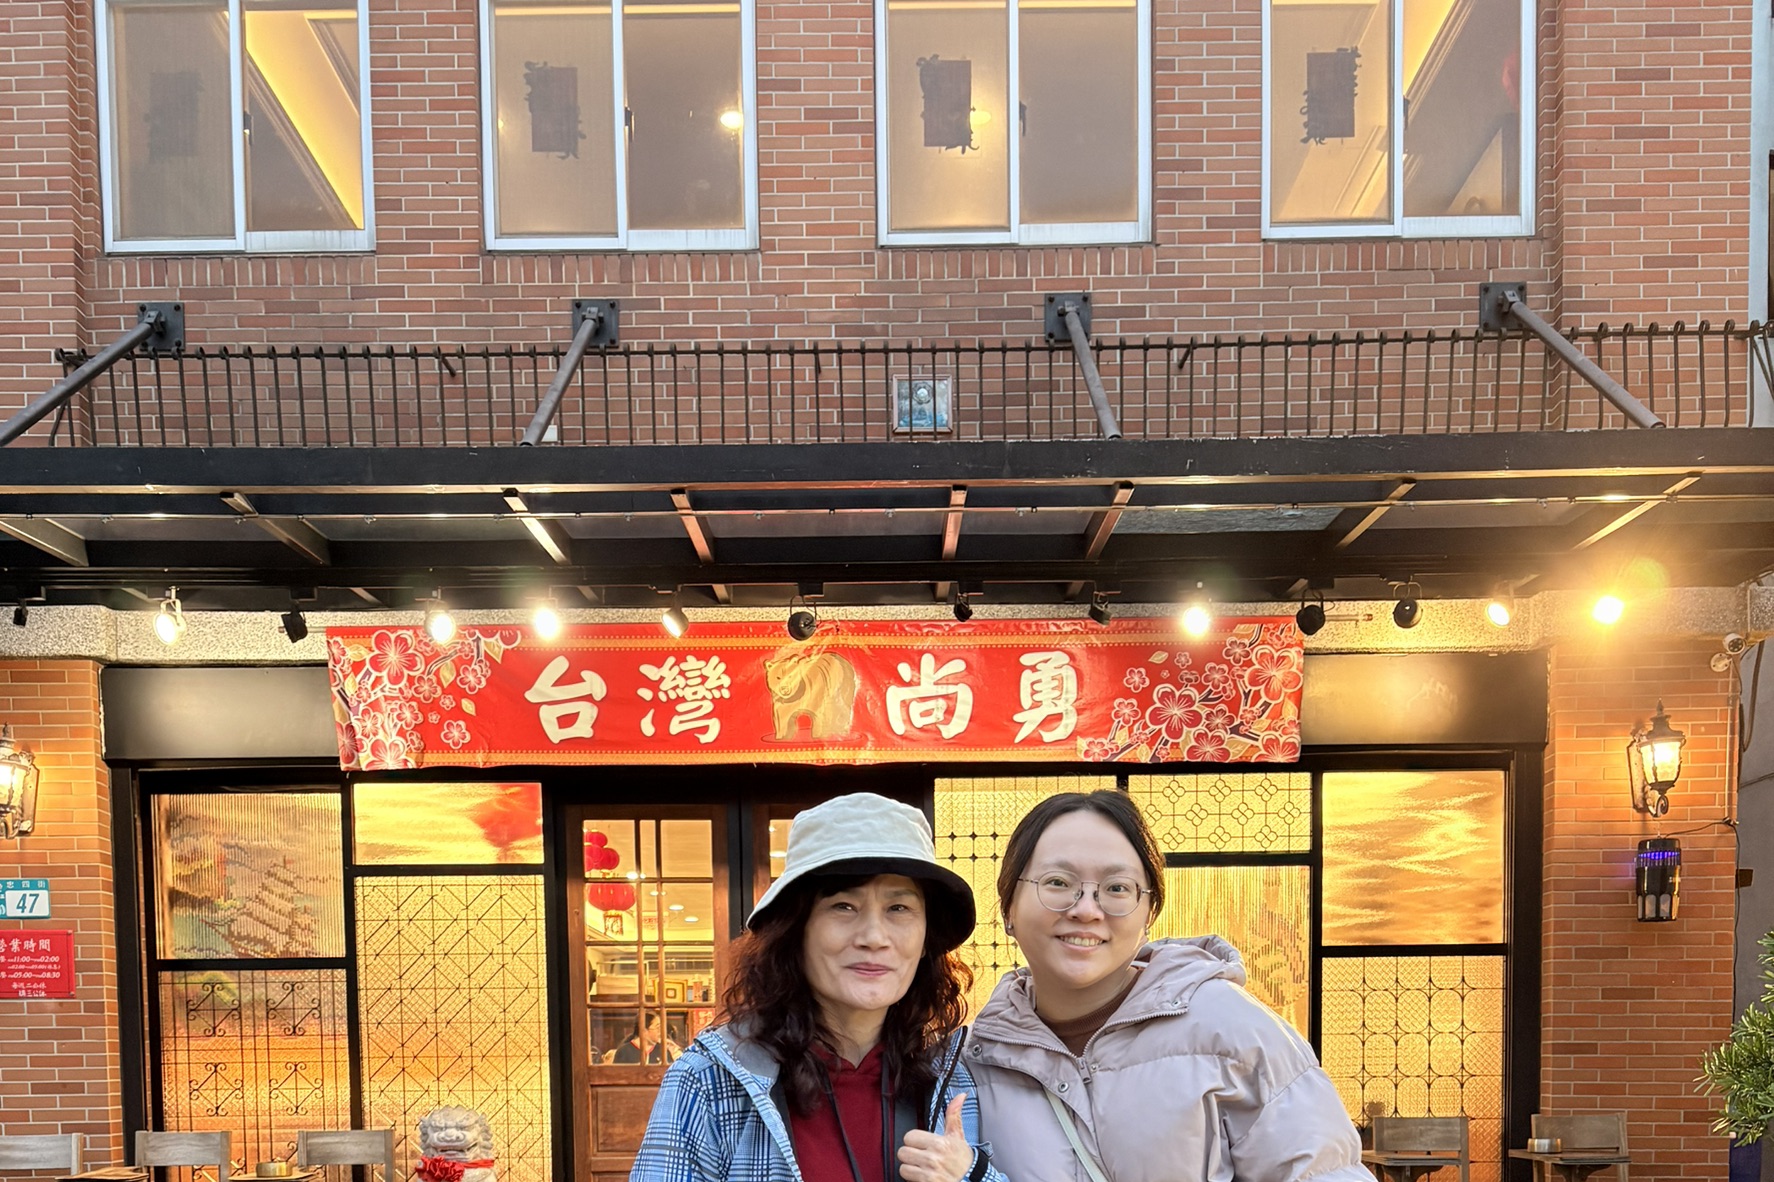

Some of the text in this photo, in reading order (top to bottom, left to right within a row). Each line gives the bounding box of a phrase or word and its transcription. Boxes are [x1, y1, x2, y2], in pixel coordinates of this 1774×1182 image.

[524, 652, 1082, 744] 台灣 尚勇
[16, 893, 40, 914] 47
